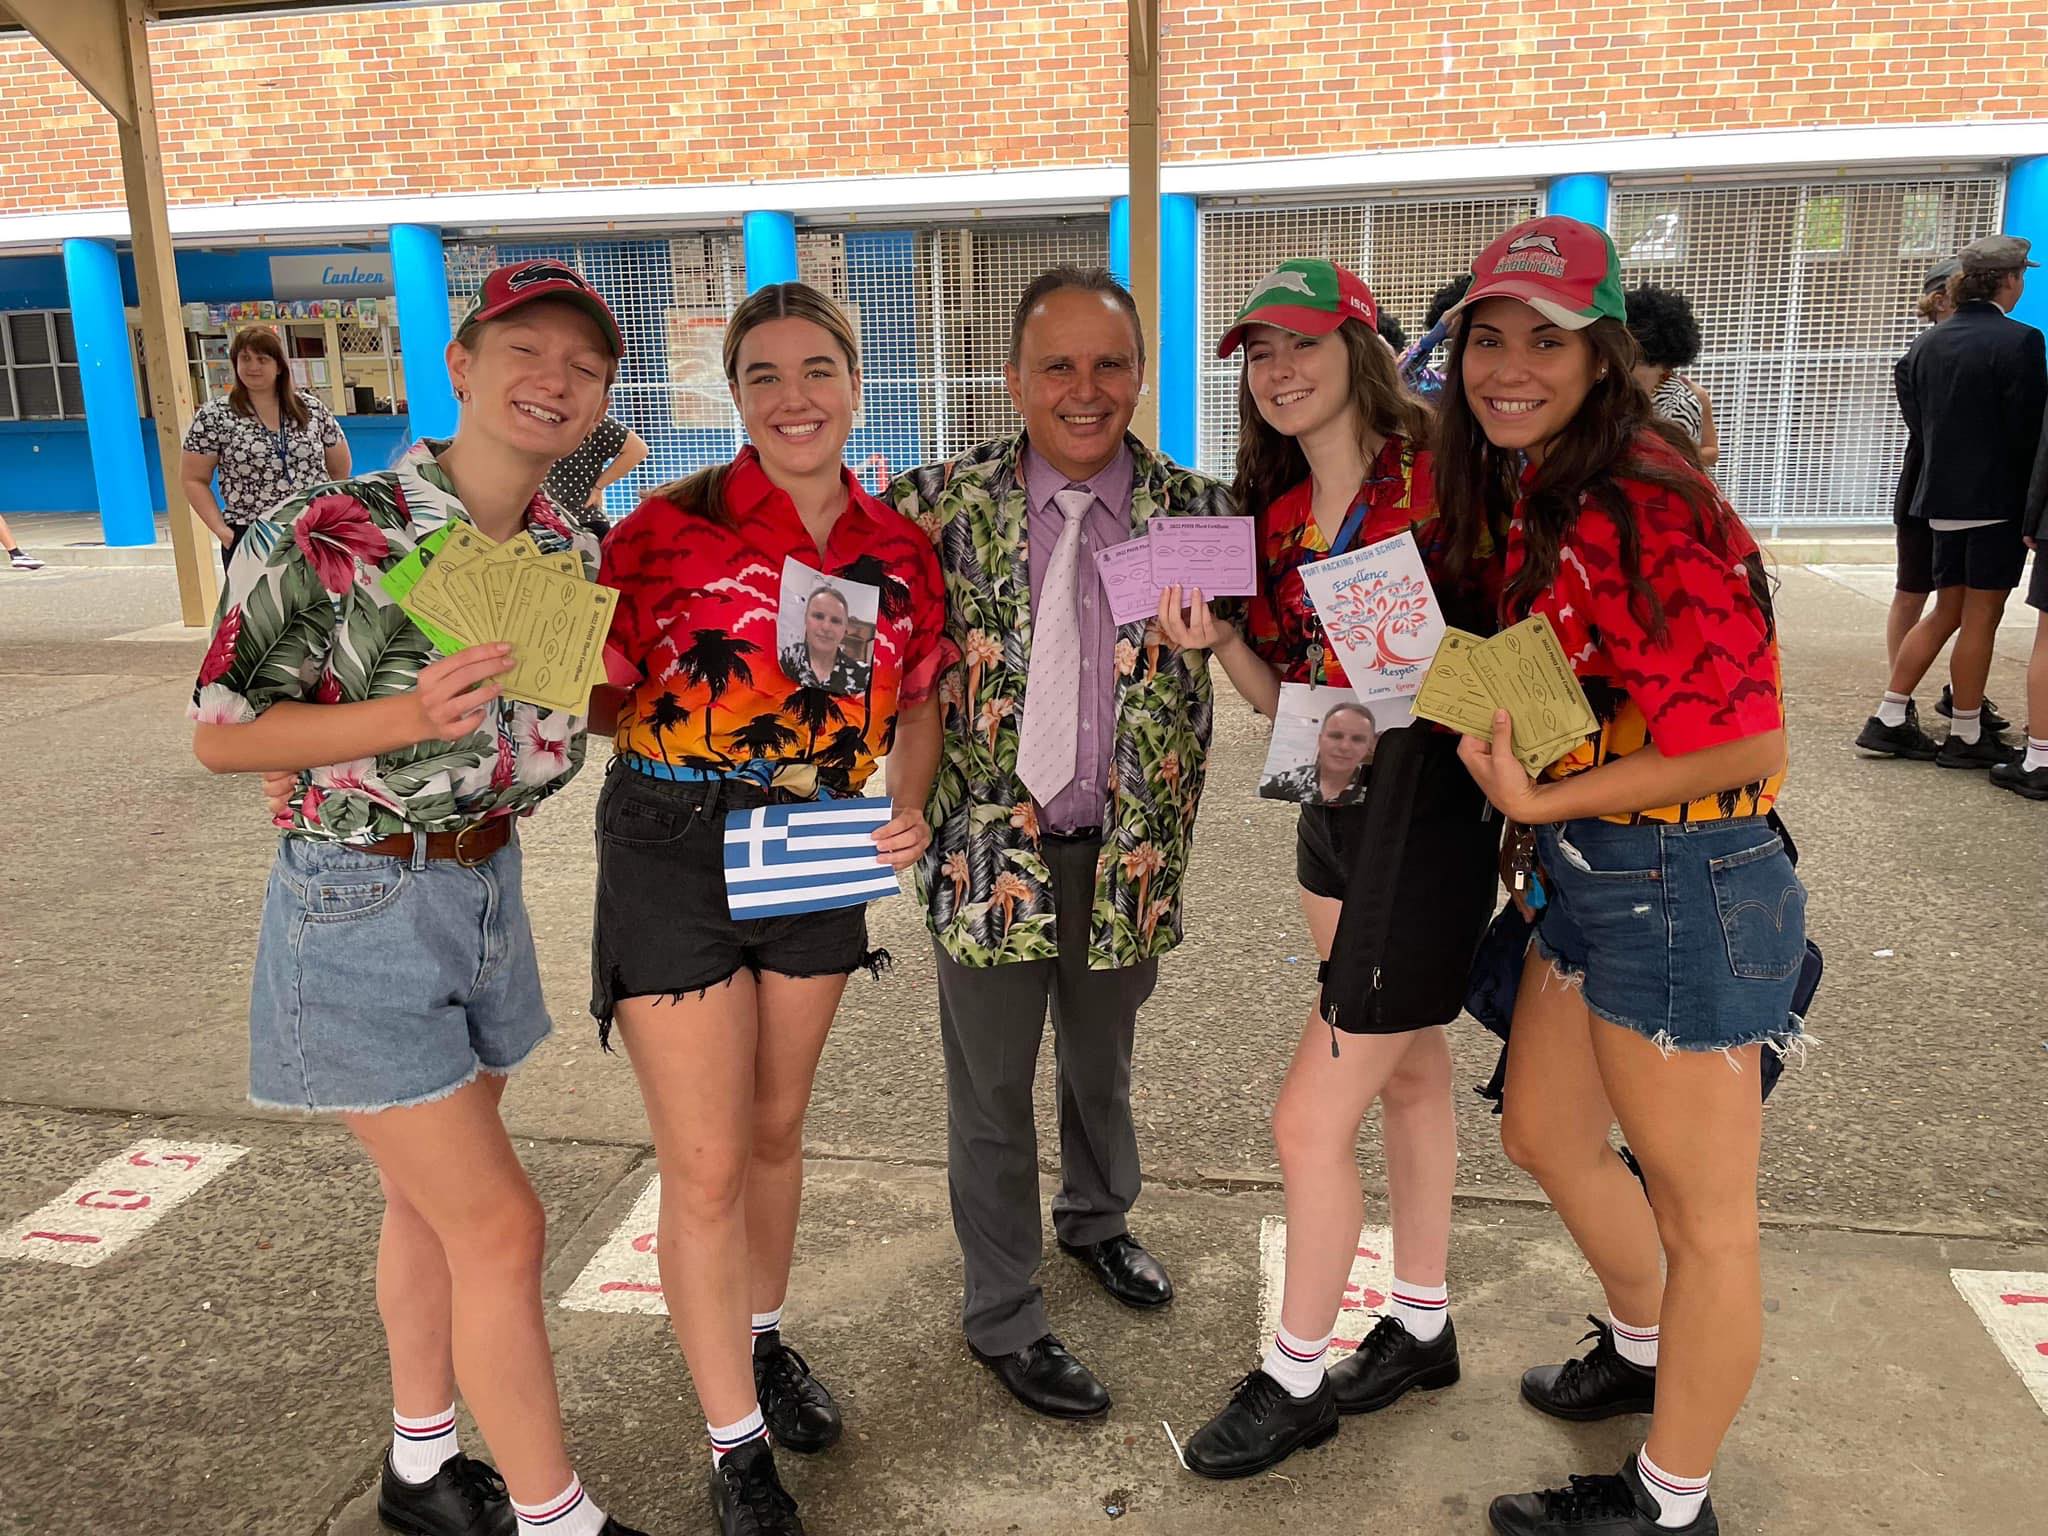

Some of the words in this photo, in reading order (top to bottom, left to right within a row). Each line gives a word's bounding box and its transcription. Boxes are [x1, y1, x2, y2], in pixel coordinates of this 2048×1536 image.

[322, 266, 385, 285] Canteen
[1301, 566, 1321, 578] PORT
[1321, 556, 1355, 574] HACKING
[1354, 551, 1375, 565] HIGH
[1374, 539, 1406, 557] SCHOOL
[1332, 568, 1389, 593] Excellence
[1380, 664, 1419, 680] Respect
